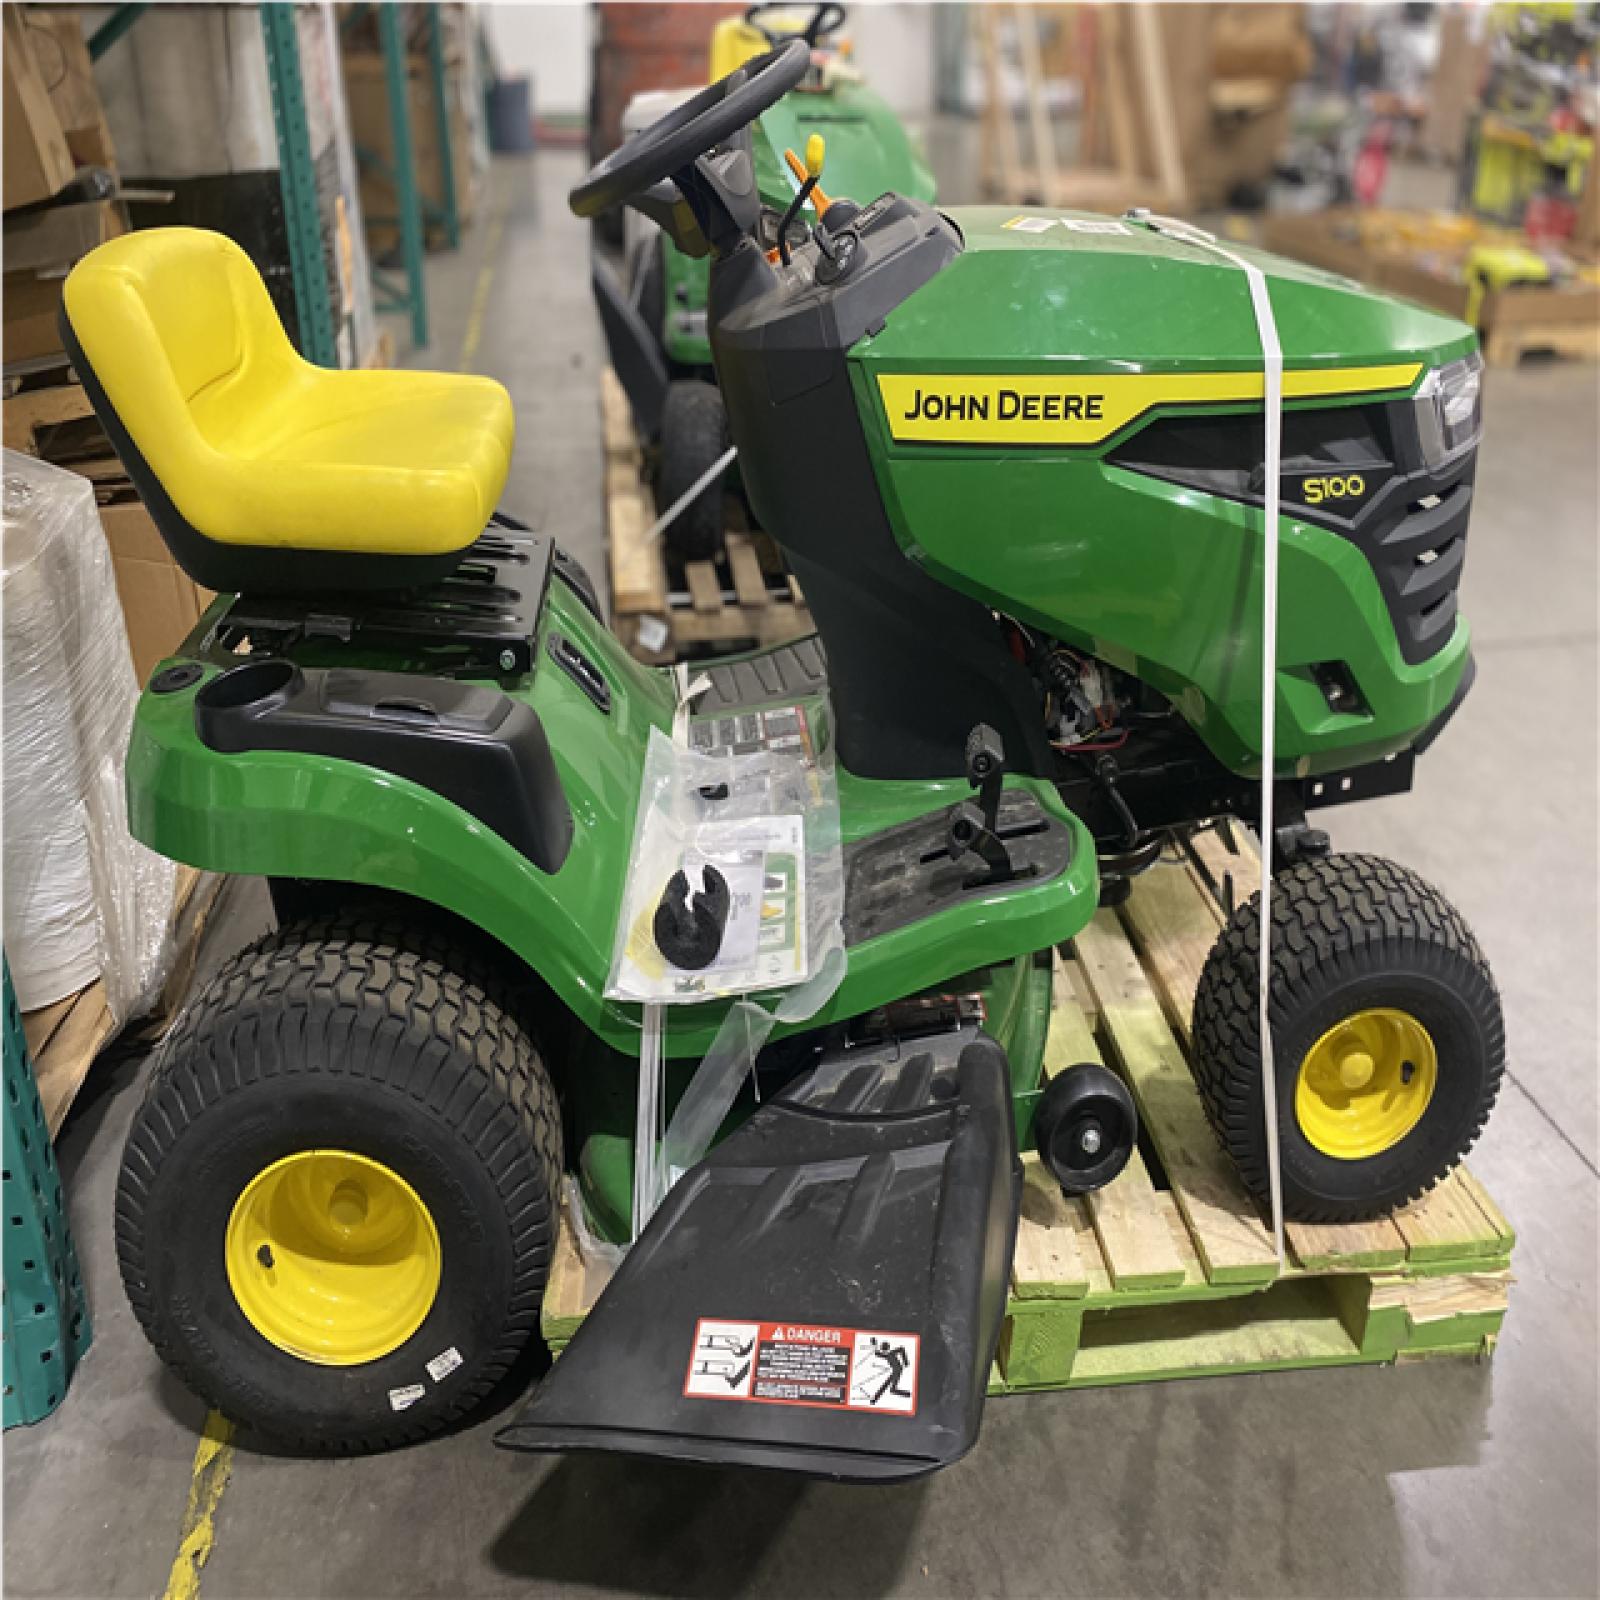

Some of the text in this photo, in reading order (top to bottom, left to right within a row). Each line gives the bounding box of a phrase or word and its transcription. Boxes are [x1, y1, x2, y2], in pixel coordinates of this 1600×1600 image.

[904, 389, 1105, 421] JOHN DEERE
[1302, 474, 1365, 504] S100
[786, 1327, 841, 1344] DANGER
